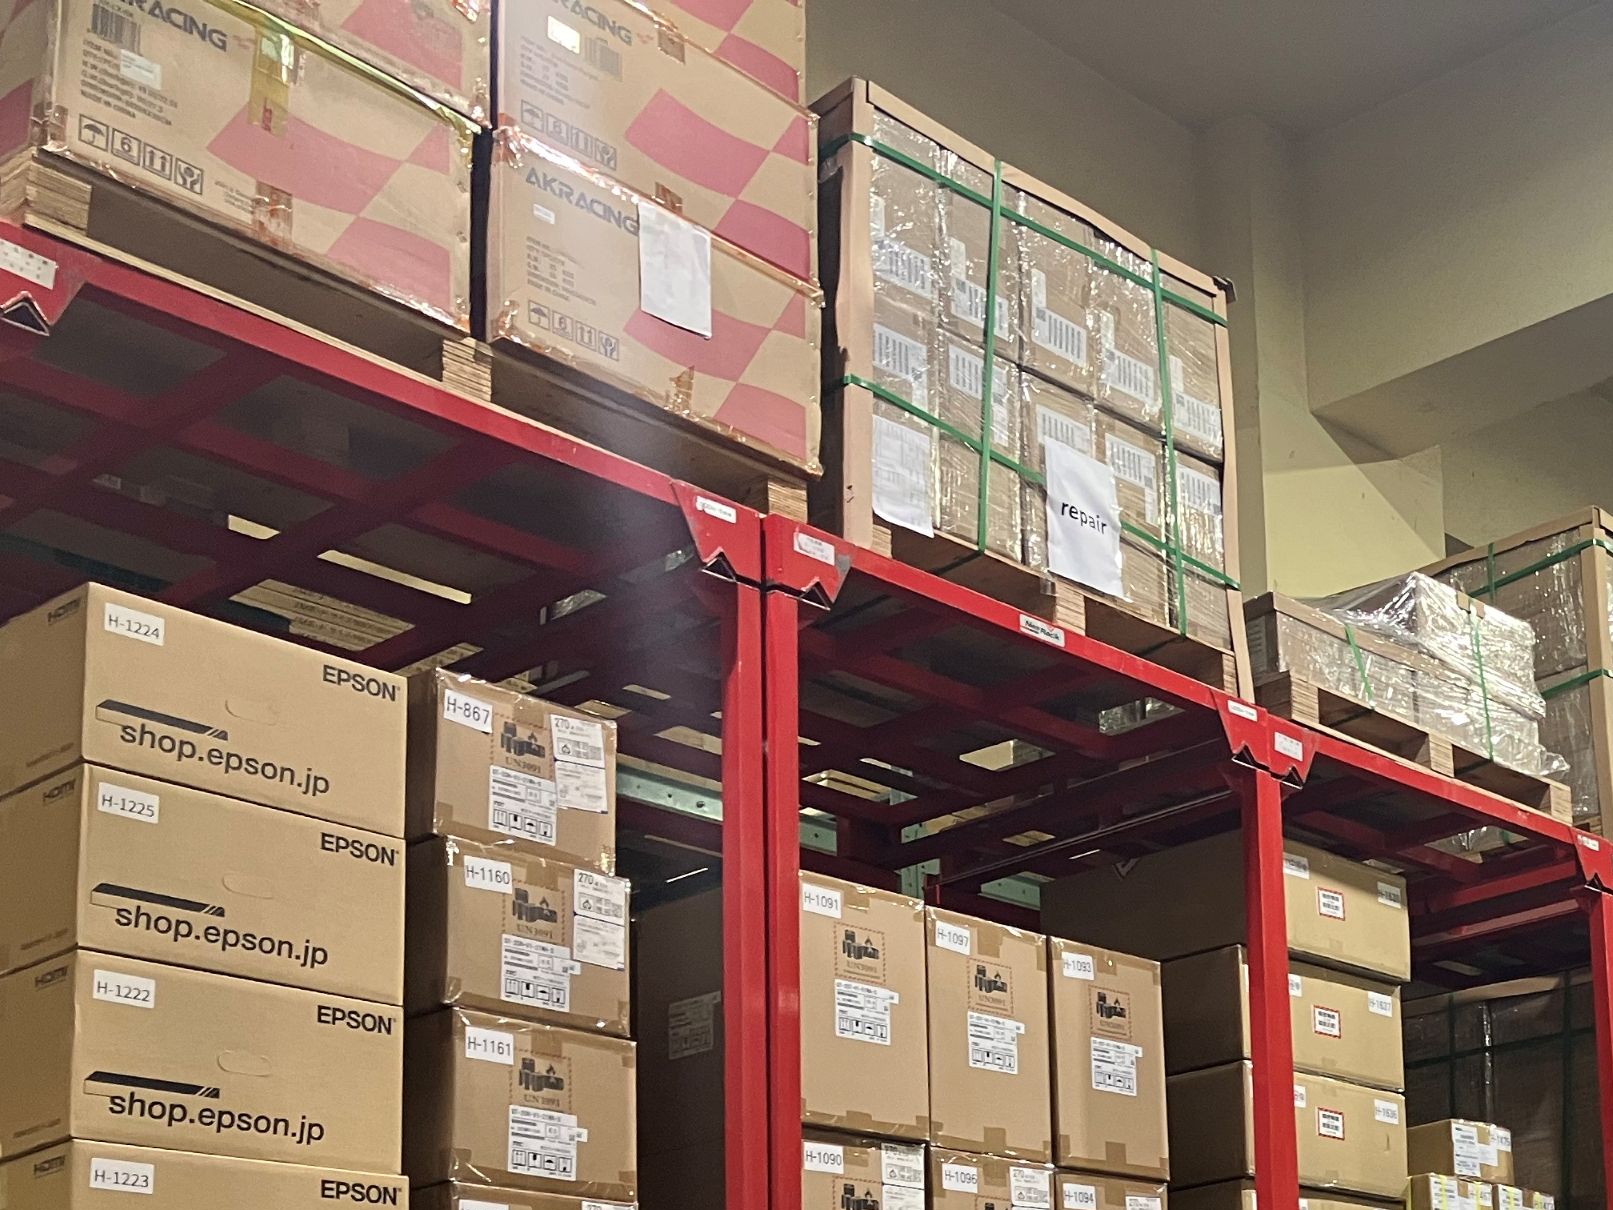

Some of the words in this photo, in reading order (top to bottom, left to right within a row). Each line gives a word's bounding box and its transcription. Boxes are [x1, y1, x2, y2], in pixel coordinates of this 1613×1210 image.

[526, 167, 640, 236] AKRACING
[1061, 501, 1107, 534] repair
[108, 613, 160, 640] H-1224
[323, 664, 397, 701] EPSON
[446, 696, 491, 726] H-867
[120, 724, 330, 797] shop.epson.jp
[101, 794, 155, 818] H-1225
[320, 832, 396, 867] EPSON
[466, 865, 510, 884] H-1160
[804, 891, 838, 910] H-1091
[115, 906, 329, 968] shop.epson.jp
[937, 928, 968, 947] H-1097
[96, 981, 150, 1002] H-1222
[317, 1005, 393, 1035] EPSON
[467, 1036, 511, 1056] H-1161
[108, 1092, 325, 1145] shop.epson.jp
[805, 1151, 842, 1166] H-1090
[94, 1169, 149, 1188] H-1223
[321, 1179, 398, 1206] EPSON
